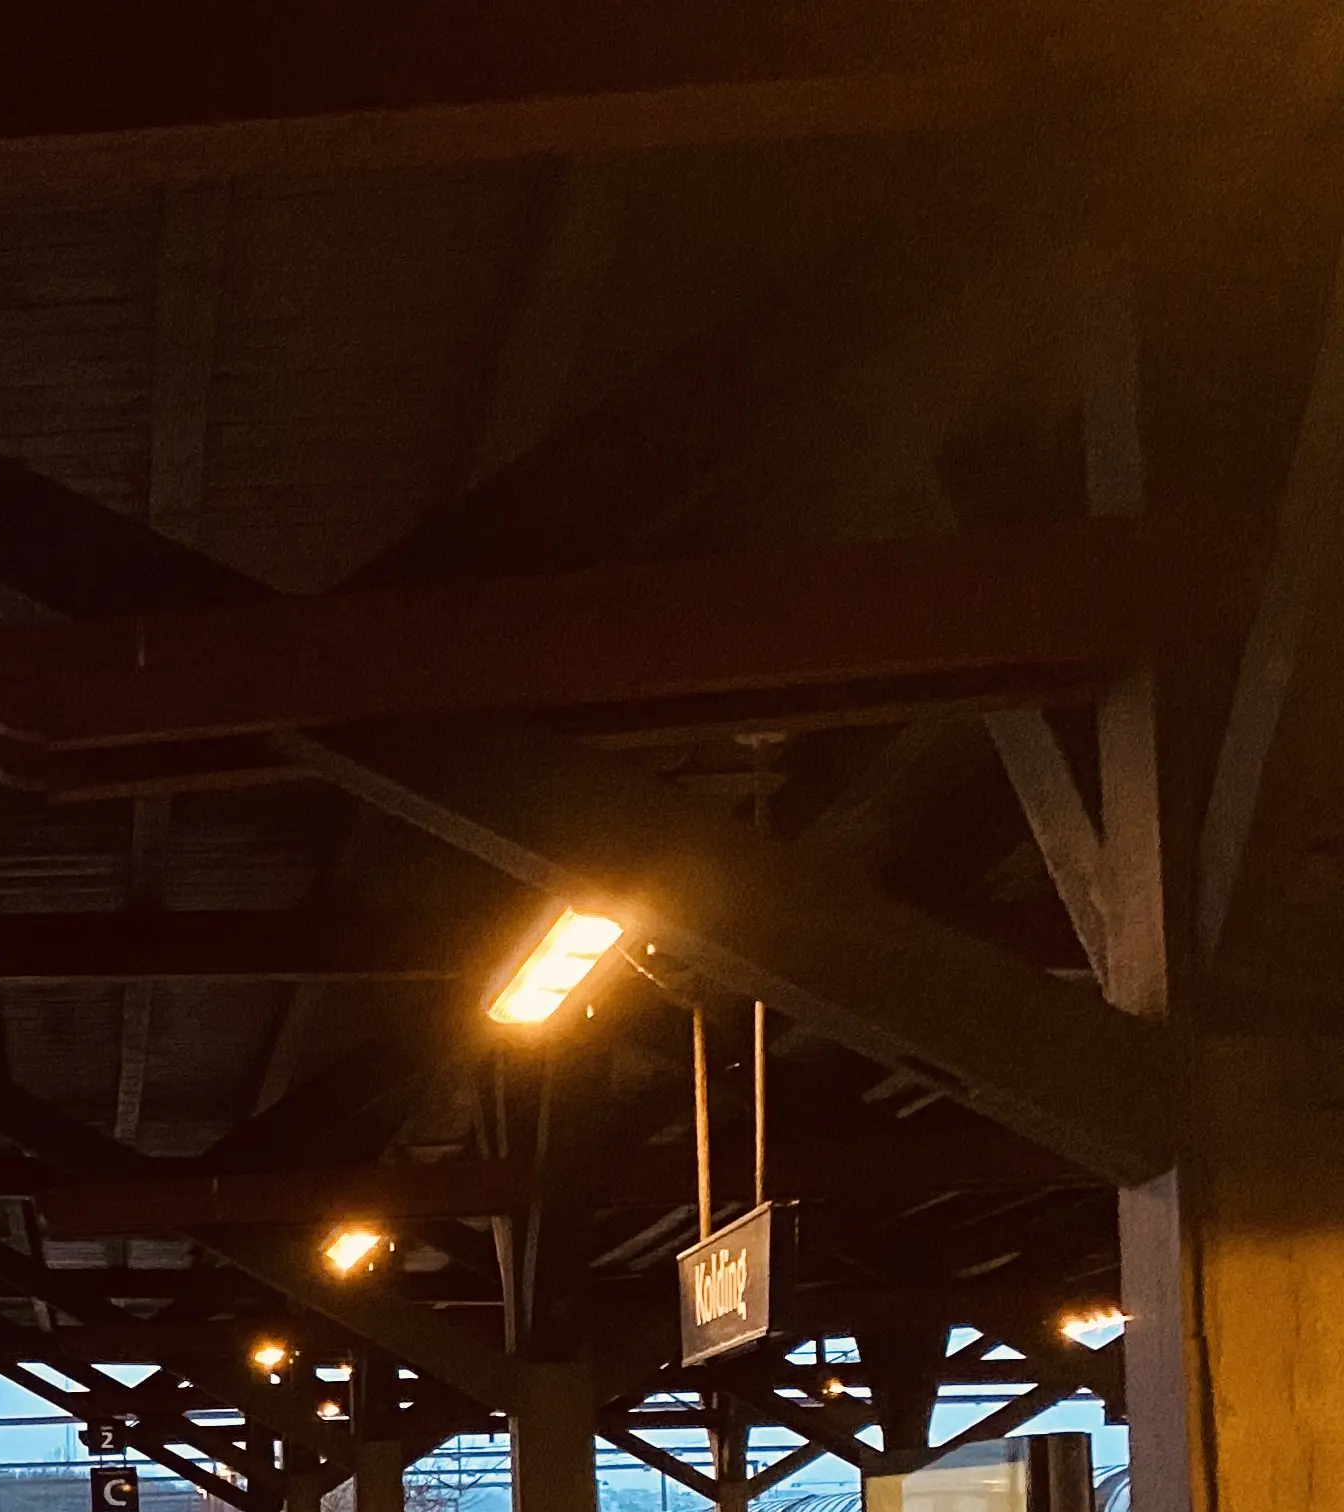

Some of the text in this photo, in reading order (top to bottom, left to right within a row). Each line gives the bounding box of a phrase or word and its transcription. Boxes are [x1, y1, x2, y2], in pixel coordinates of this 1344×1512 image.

[694, 1248, 747, 1326] Kolding
[100, 1431, 115, 1449] 2
[103, 1478, 127, 1507] C
